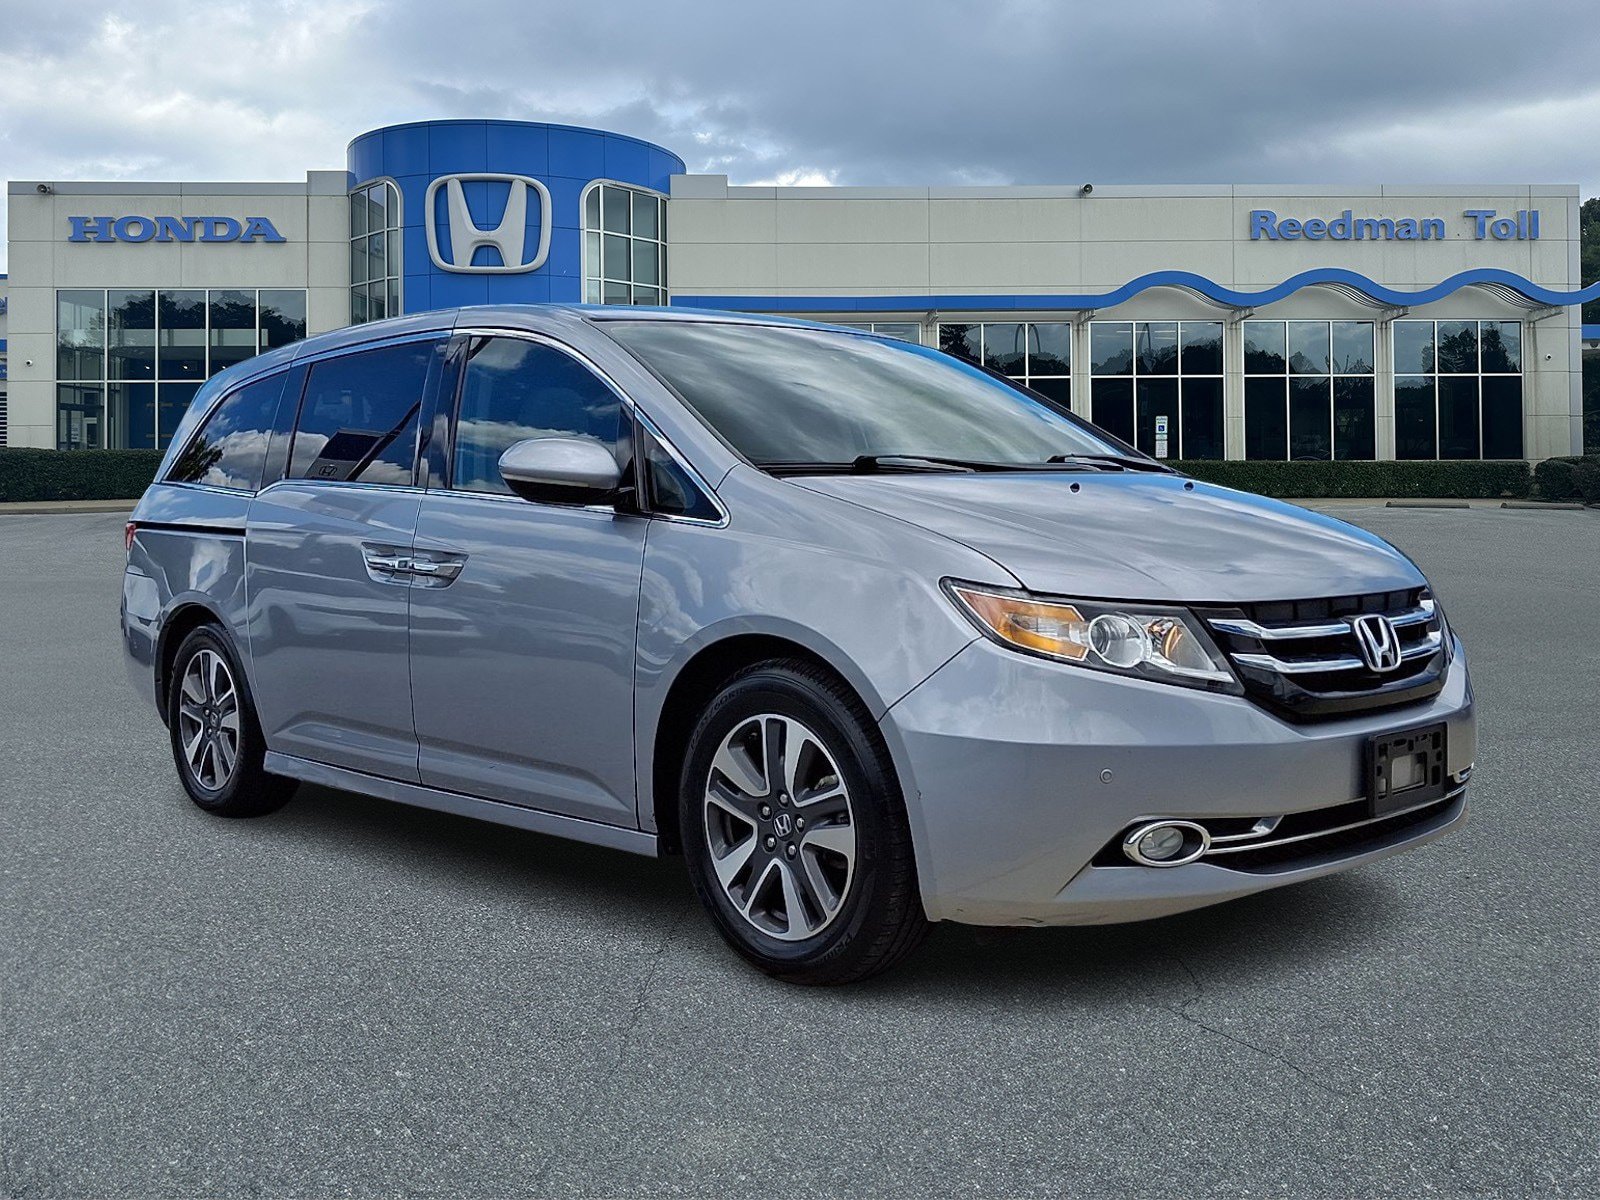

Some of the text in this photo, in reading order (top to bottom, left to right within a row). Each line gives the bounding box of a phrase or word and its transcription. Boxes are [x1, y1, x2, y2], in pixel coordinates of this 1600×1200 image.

[67, 215, 287, 243] HONDA
[1249, 209, 1539, 241] Reedman Toll
